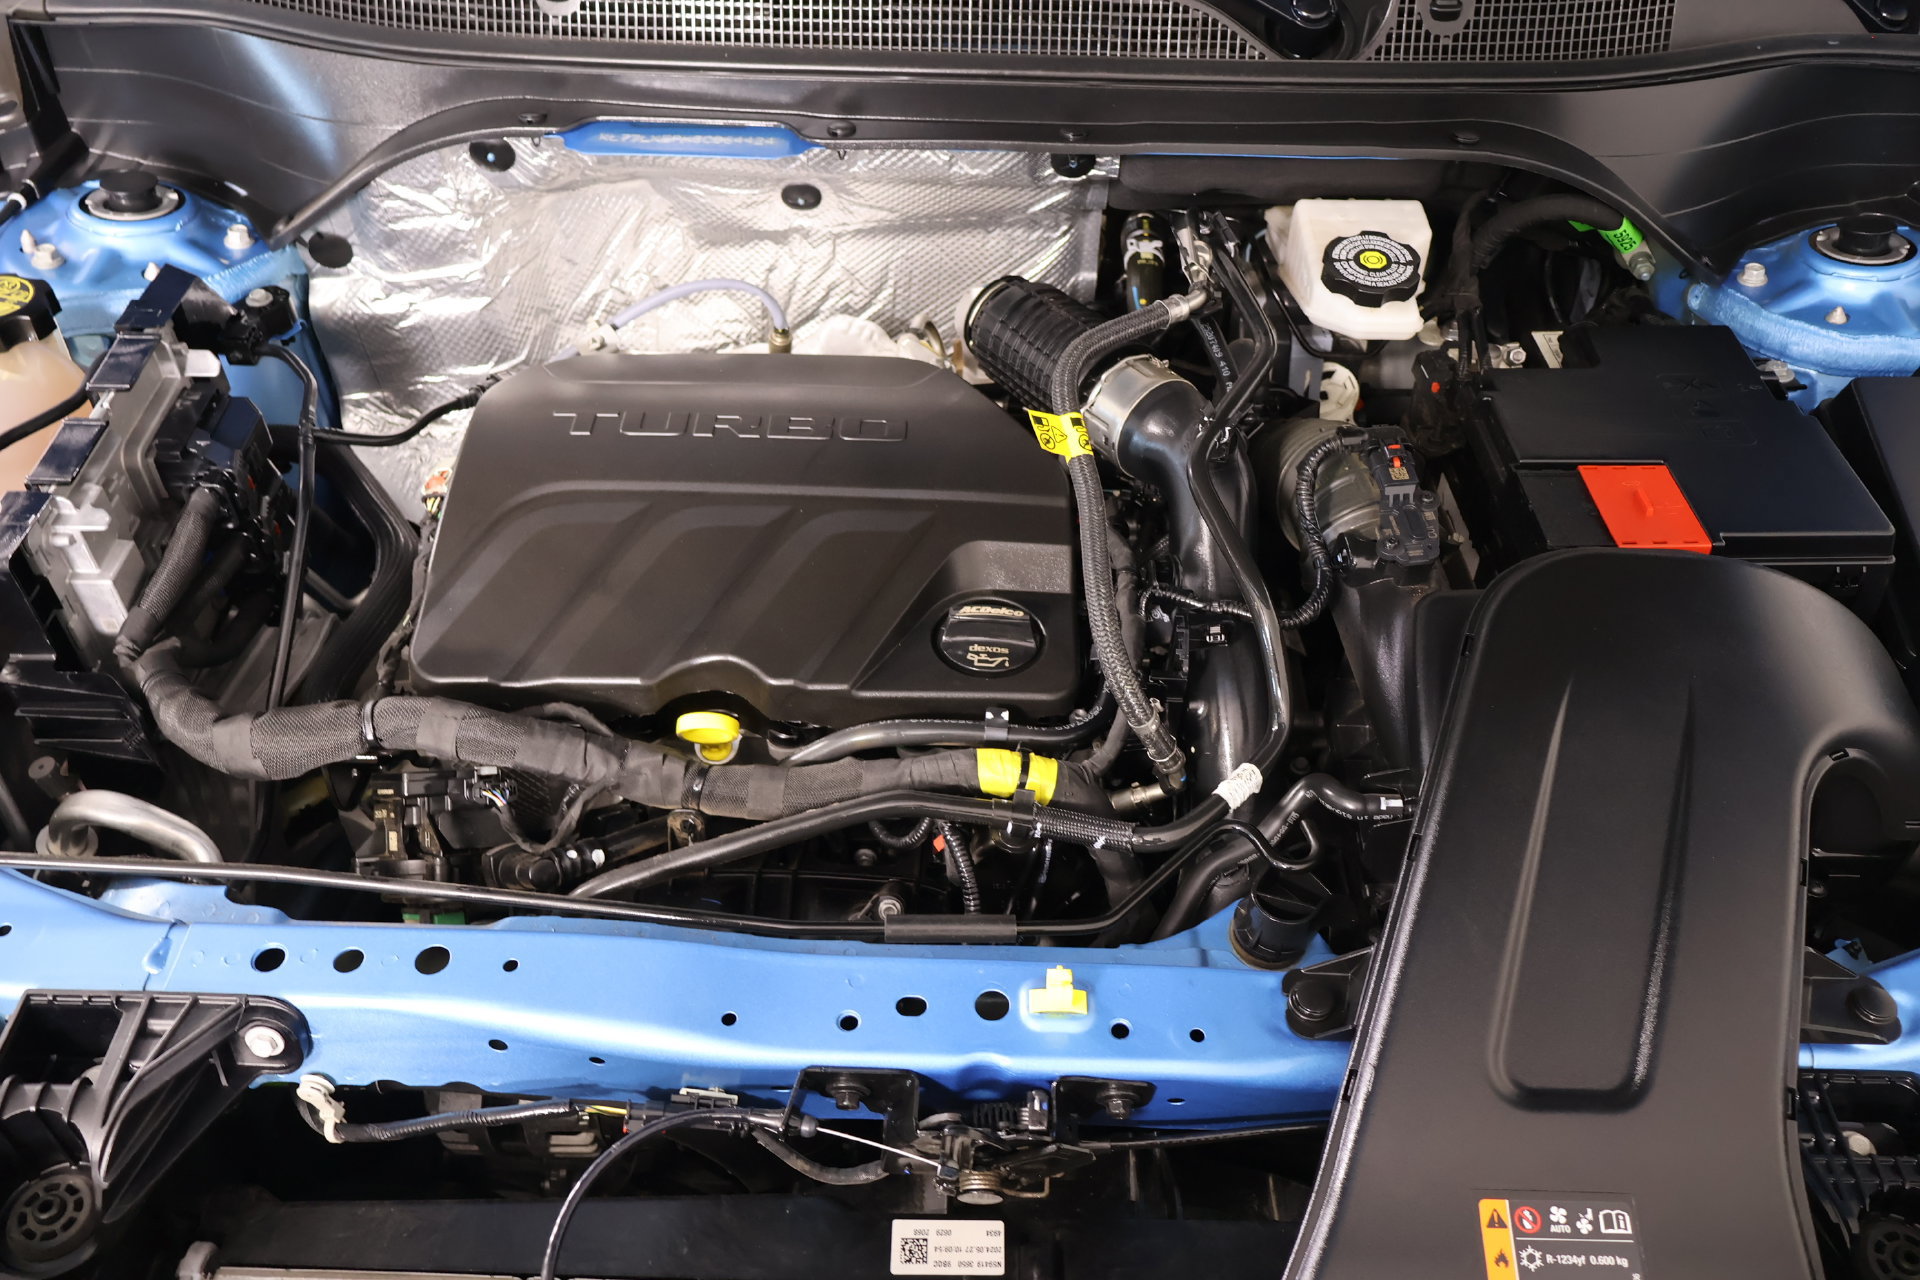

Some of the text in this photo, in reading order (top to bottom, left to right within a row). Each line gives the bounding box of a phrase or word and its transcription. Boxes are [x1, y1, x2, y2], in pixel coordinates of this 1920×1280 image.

[1613, 229, 1637, 251] 5925
[552, 411, 908, 441] TURBO
[957, 605, 1025, 617] ACDelco
[968, 643, 1009, 654] dexos
[1550, 1224, 1572, 1234] AUTO
[1545, 1254, 1629, 1269] R-1234yf 0.600 kg
